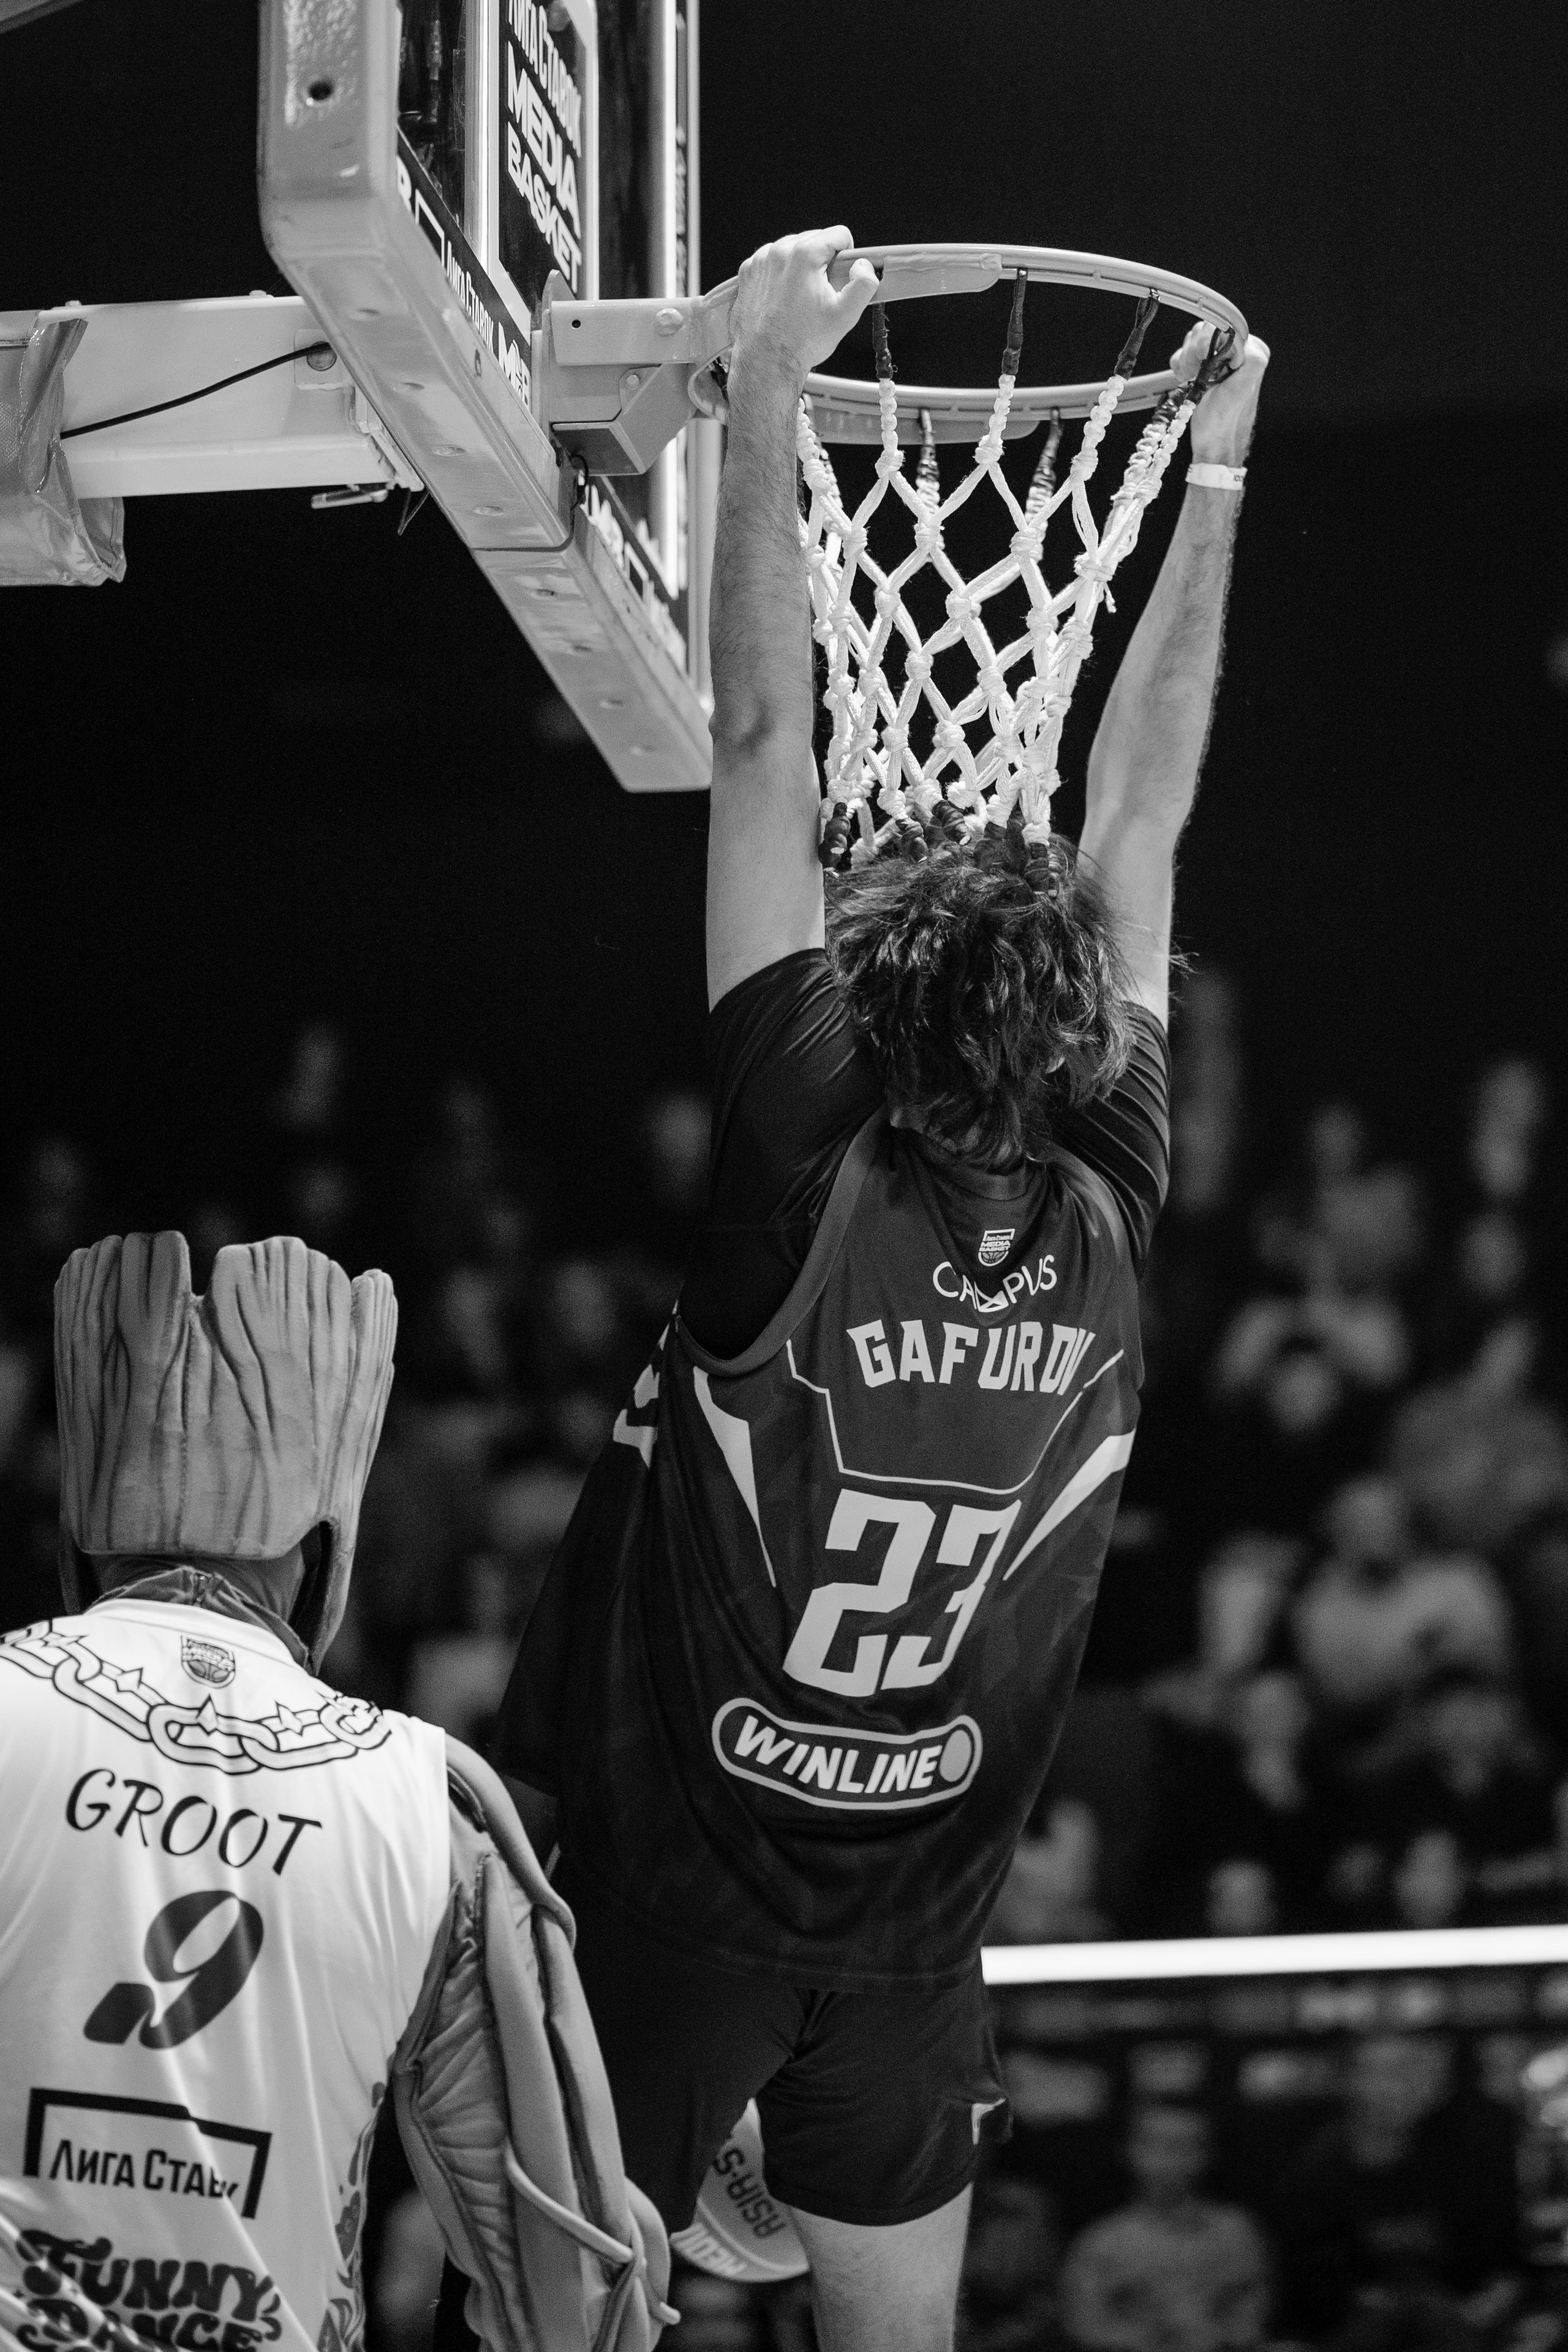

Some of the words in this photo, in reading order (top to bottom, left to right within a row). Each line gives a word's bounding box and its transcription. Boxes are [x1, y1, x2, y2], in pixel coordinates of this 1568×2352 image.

[508, 40, 581, 239] MEDIA
[508, 121, 581, 294] BASKET
[782, 1488, 1022, 1697] 23
[66, 1768, 323, 1876] GROOT
[734, 1715, 943, 1794] WINLINE
[83, 1890, 264, 2049] 9
[16, 2229, 273, 2322] FUNNY
